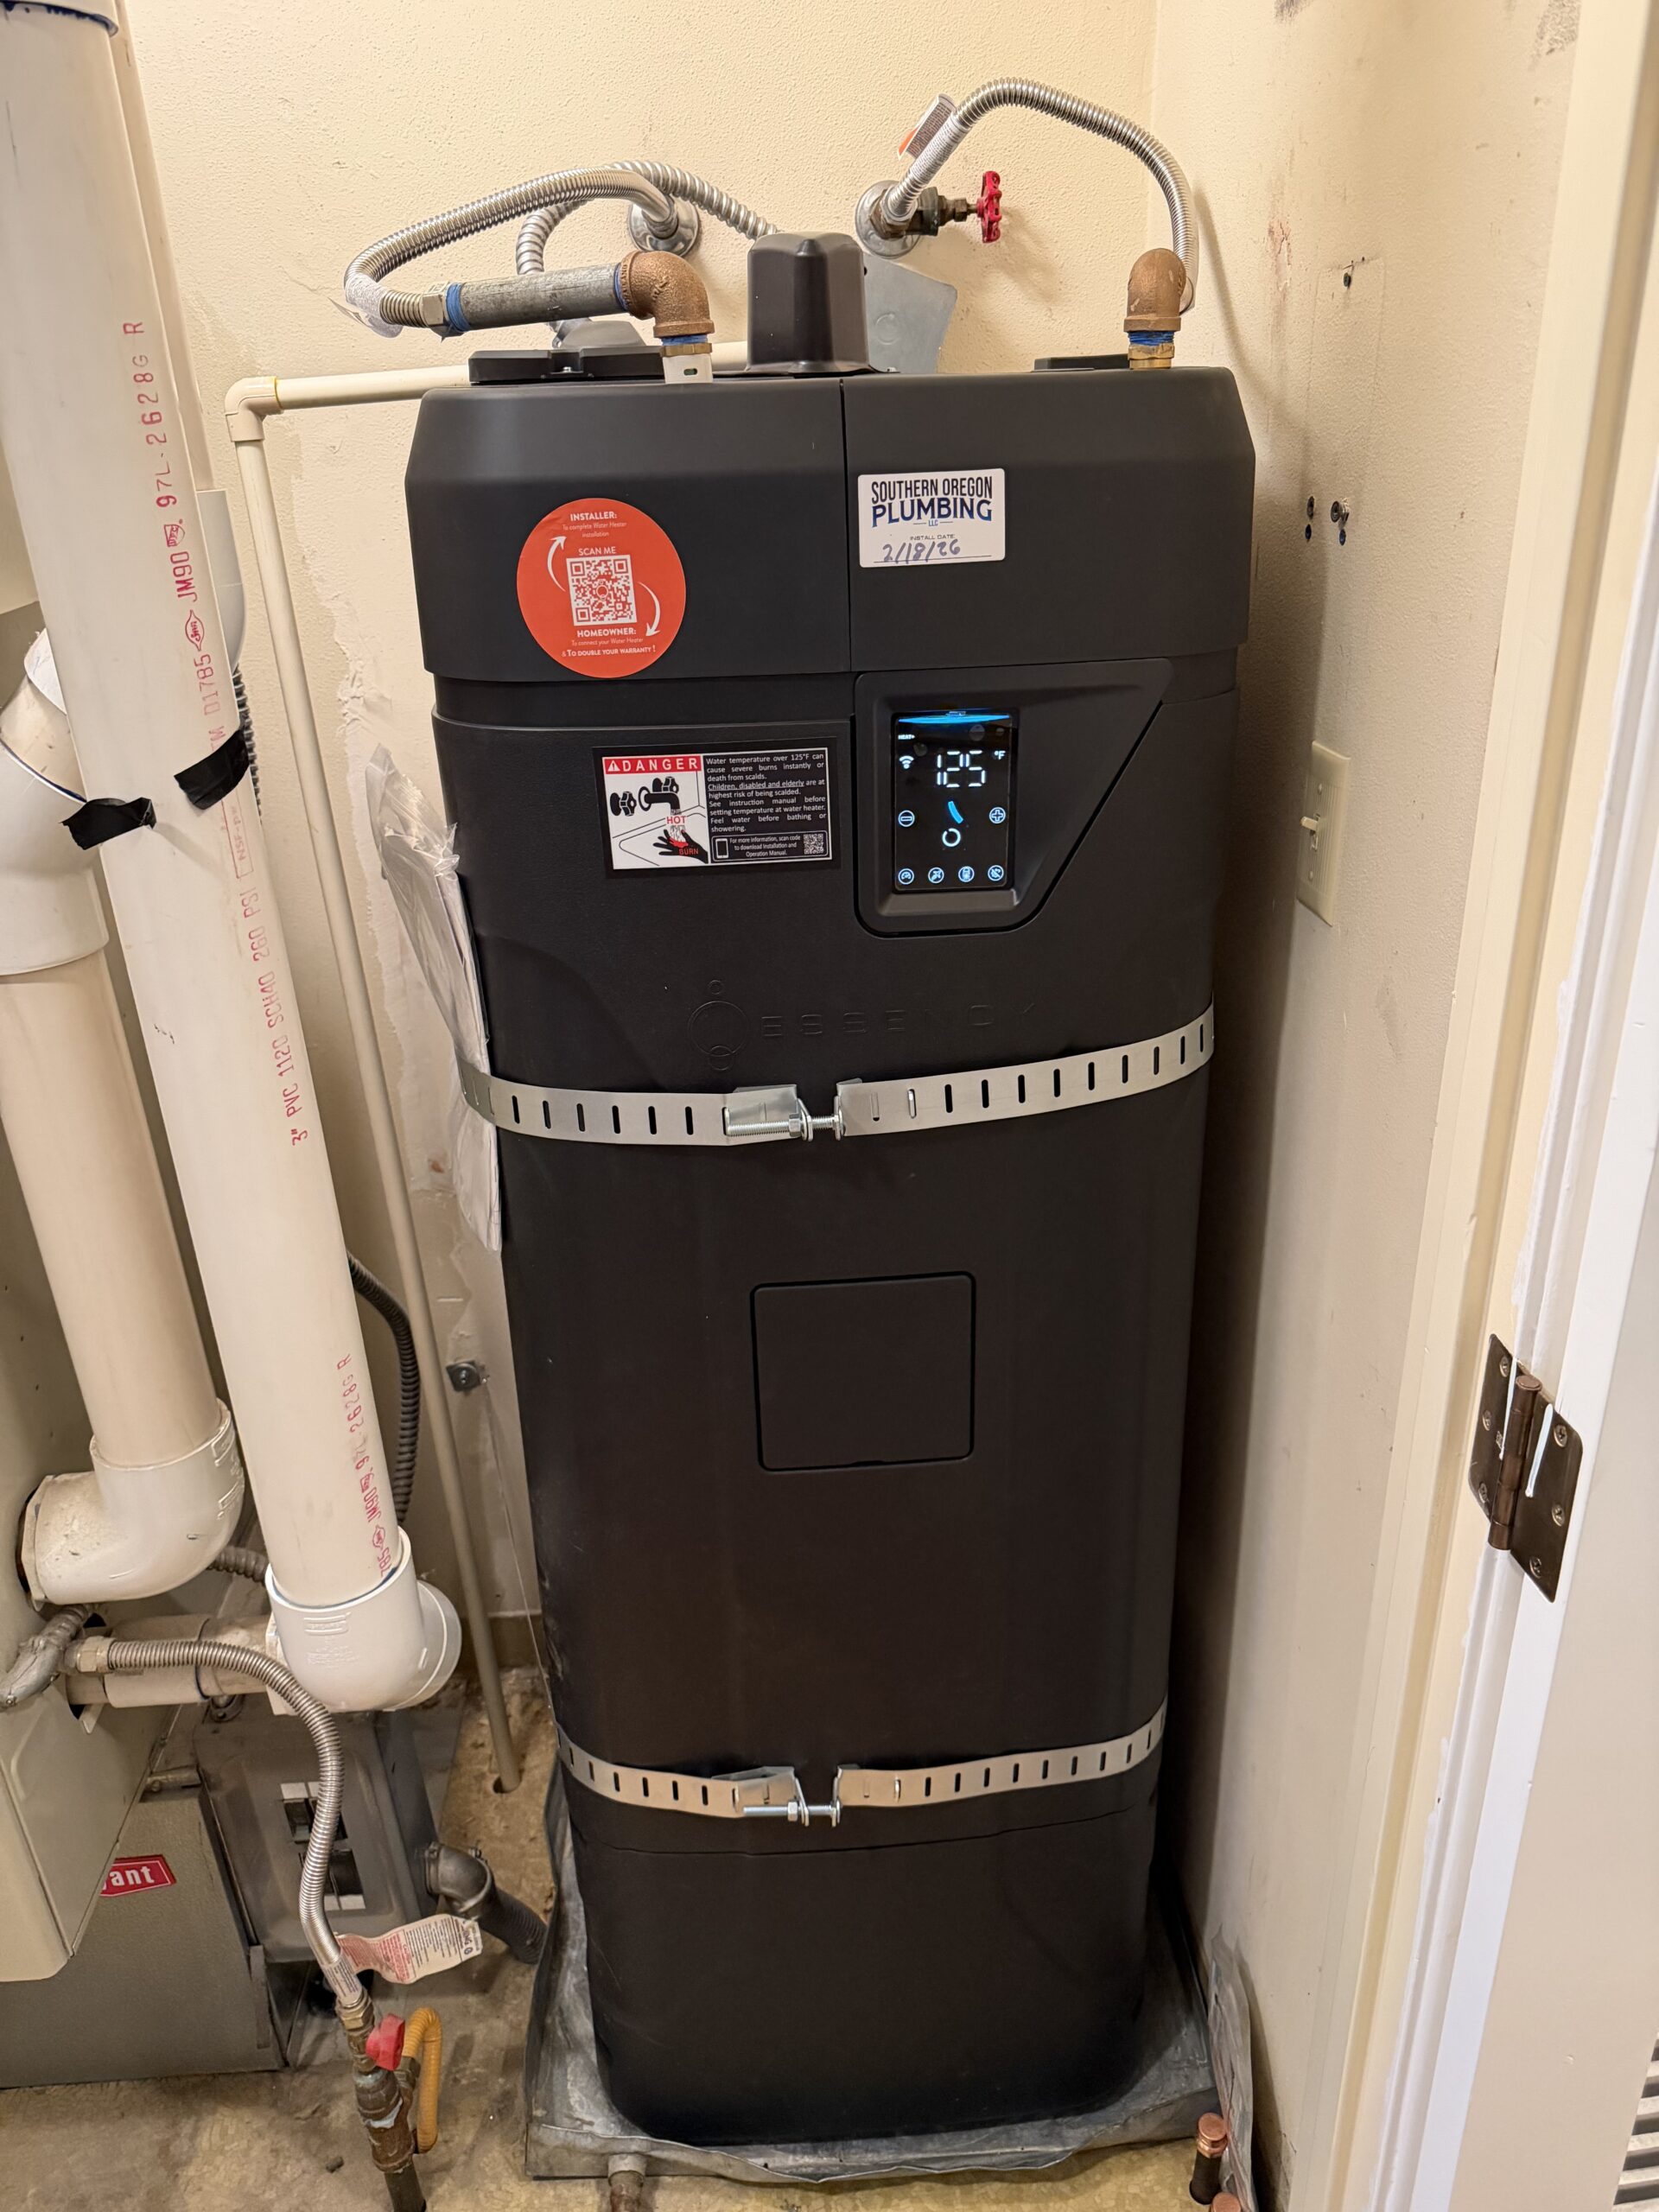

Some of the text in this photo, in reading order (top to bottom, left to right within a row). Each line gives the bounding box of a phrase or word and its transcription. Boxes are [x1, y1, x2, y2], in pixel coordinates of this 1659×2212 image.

[123, 321, 144, 335] R
[872, 476, 992, 504] SOUTHERN OREGON
[570, 512, 617, 521] INSTALLER:
[872, 498, 992, 528] PLUMBING
[882, 539, 961, 564] 2/18/26
[169, 550, 198, 603] JM90
[577, 627, 636, 638] HOMEOWNER:
[193, 653, 222, 716] D1785
[622, 758, 698, 772] DANGER
[937, 750, 986, 788] 125
[667, 816, 686, 824] HOT
[239, 887, 262, 918] PSI
[248, 925, 270, 962] 260
[257, 970, 284, 1029] SCH40
[271, 1034, 295, 1077] 1120
[282, 1082, 302, 1118] PVC
[102, 1866, 155, 1891] ant
